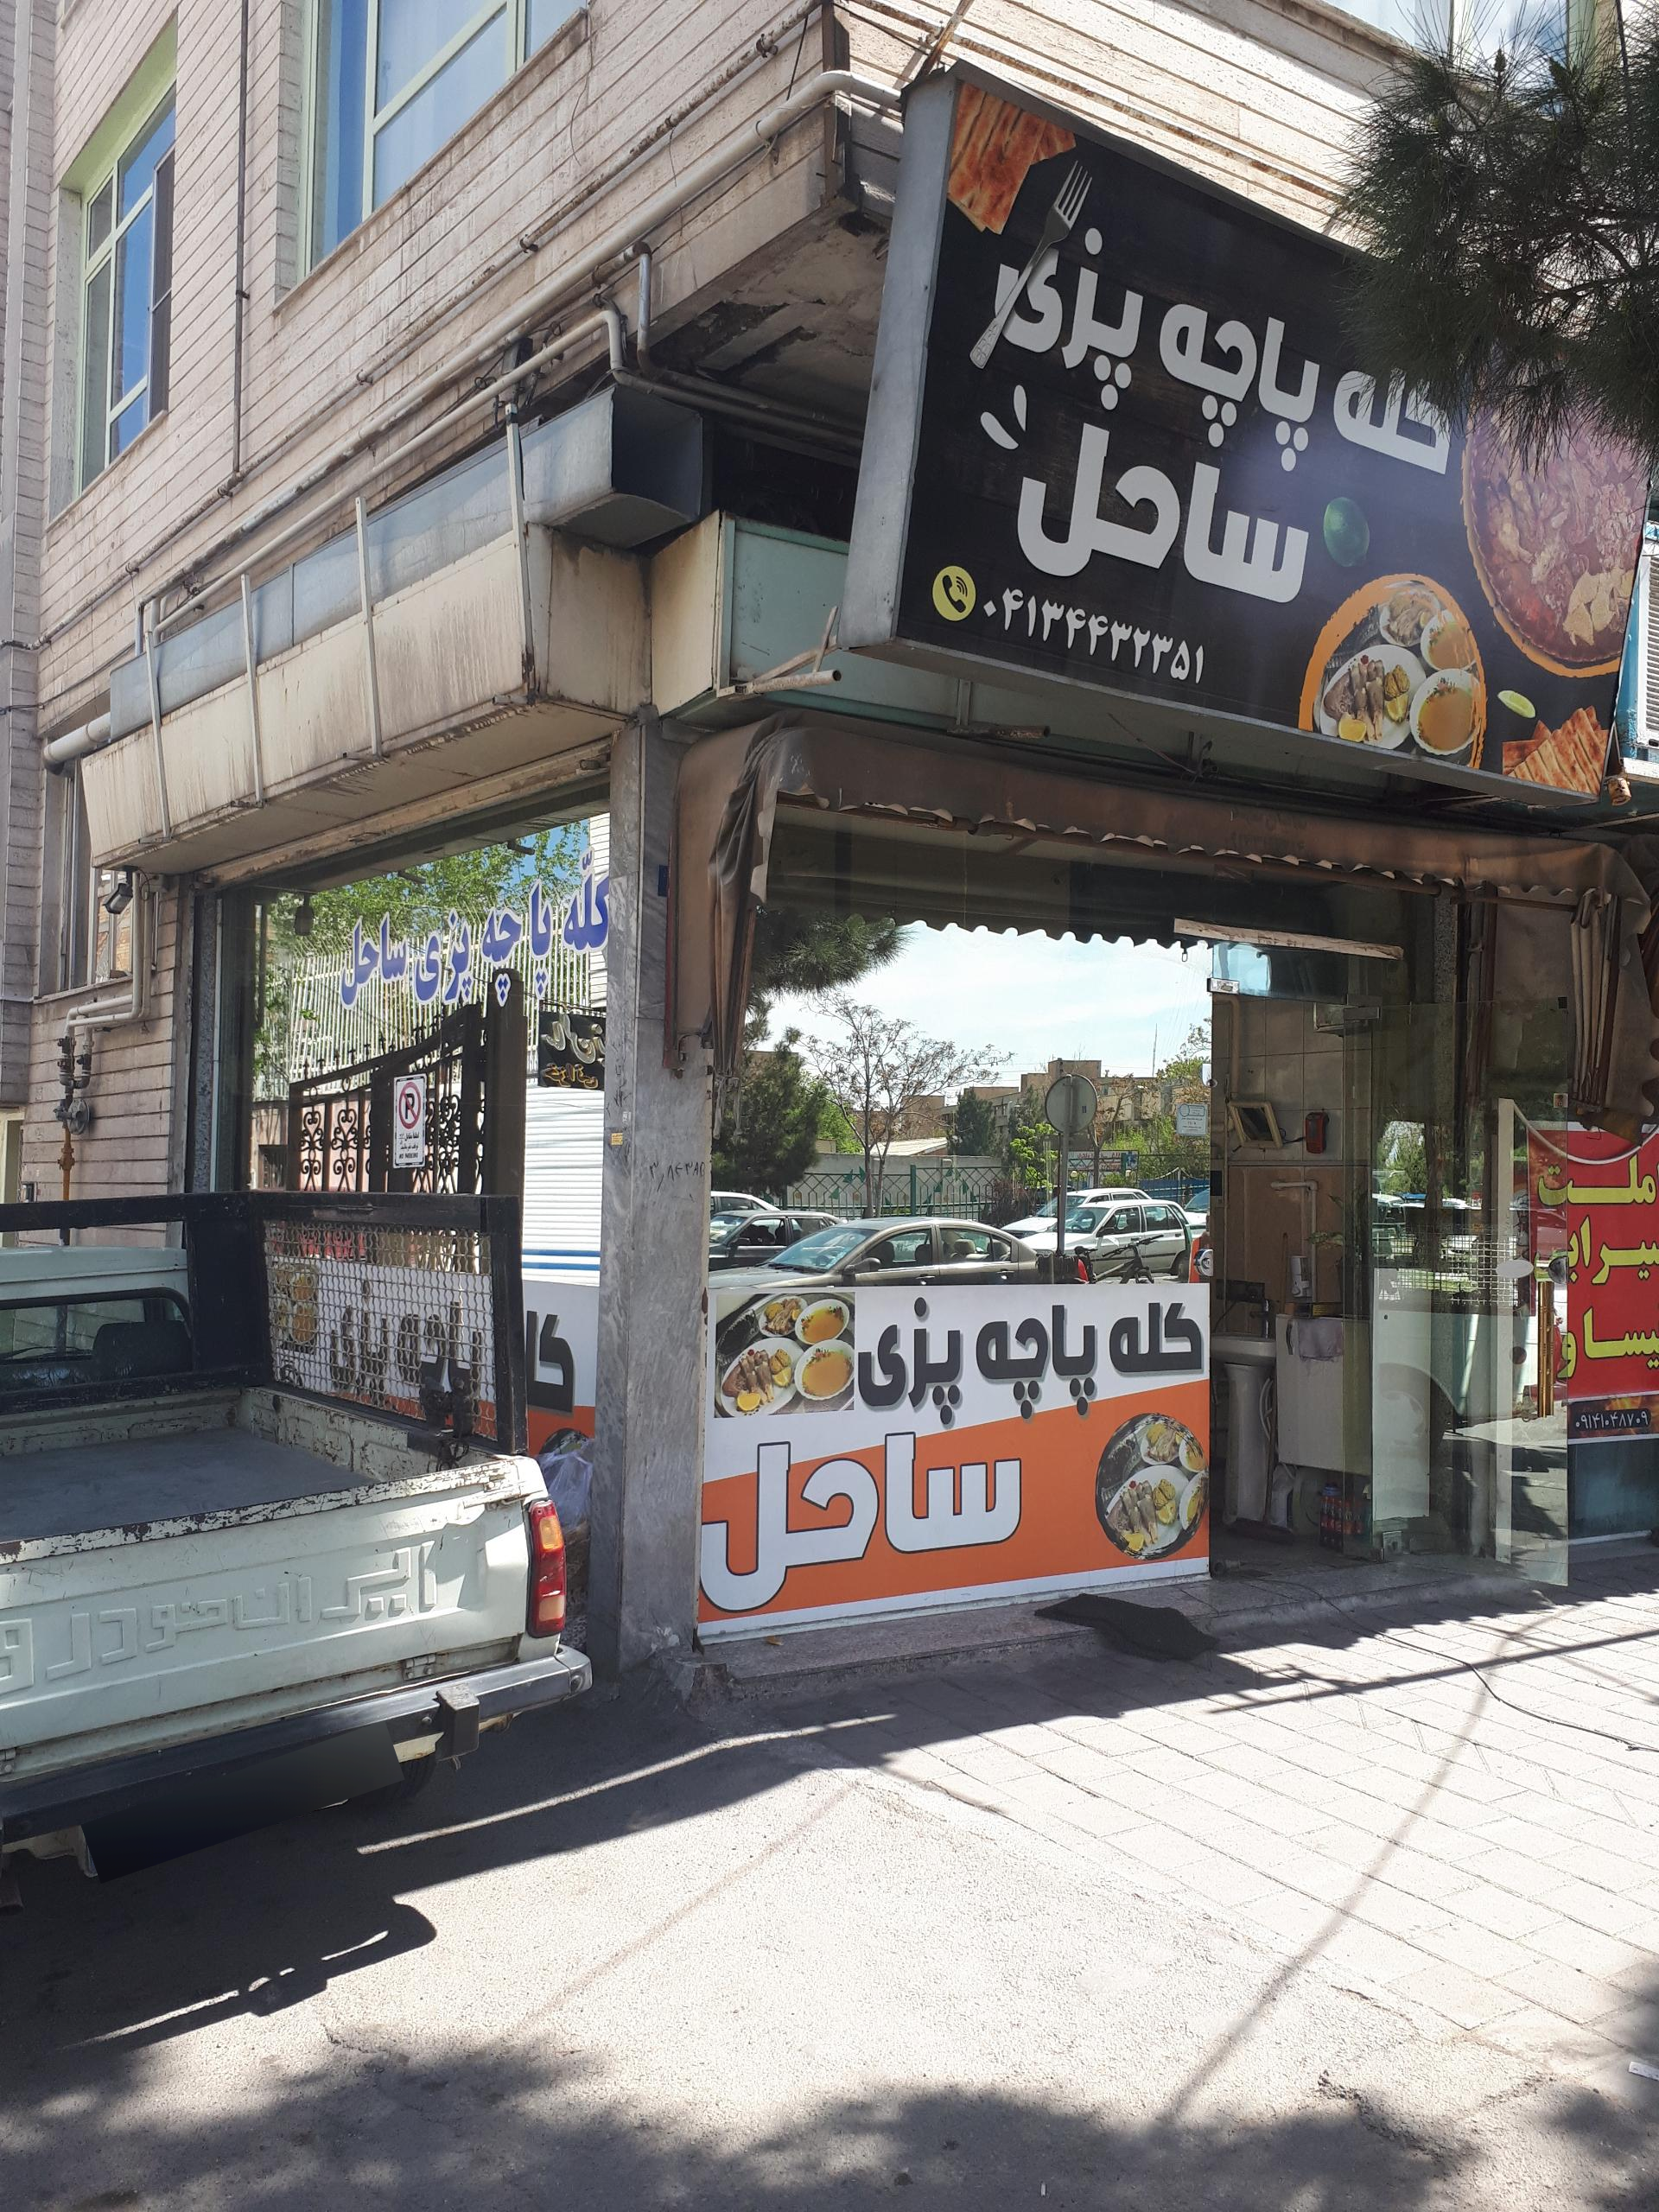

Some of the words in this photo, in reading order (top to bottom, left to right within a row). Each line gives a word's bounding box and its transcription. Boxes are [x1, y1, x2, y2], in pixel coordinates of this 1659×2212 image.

[994, 226, 1144, 410] پزی
[1159, 300, 1319, 472] پاچه
[1017, 423, 1309, 604] ساحل
[983, 587, 1205, 684] ۰۴۱۳۴۴۳۲۳۵۱
[340, 910, 408, 1010] ساحل
[413, 907, 474, 1006] پزی
[480, 878, 553, 1007] پاچه
[1538, 1153, 1659, 1207] ملت
[858, 1297, 964, 1427] پزی
[976, 1304, 1098, 1421] پاچه
[1109, 1301, 1205, 1376] کله
[1575, 1410, 1649, 1431] ۰۹۱۴۱۰۴۸۷۰۹
[700, 1432, 1022, 1613] ساحل
[234, 1540, 438, 1630] ایران
